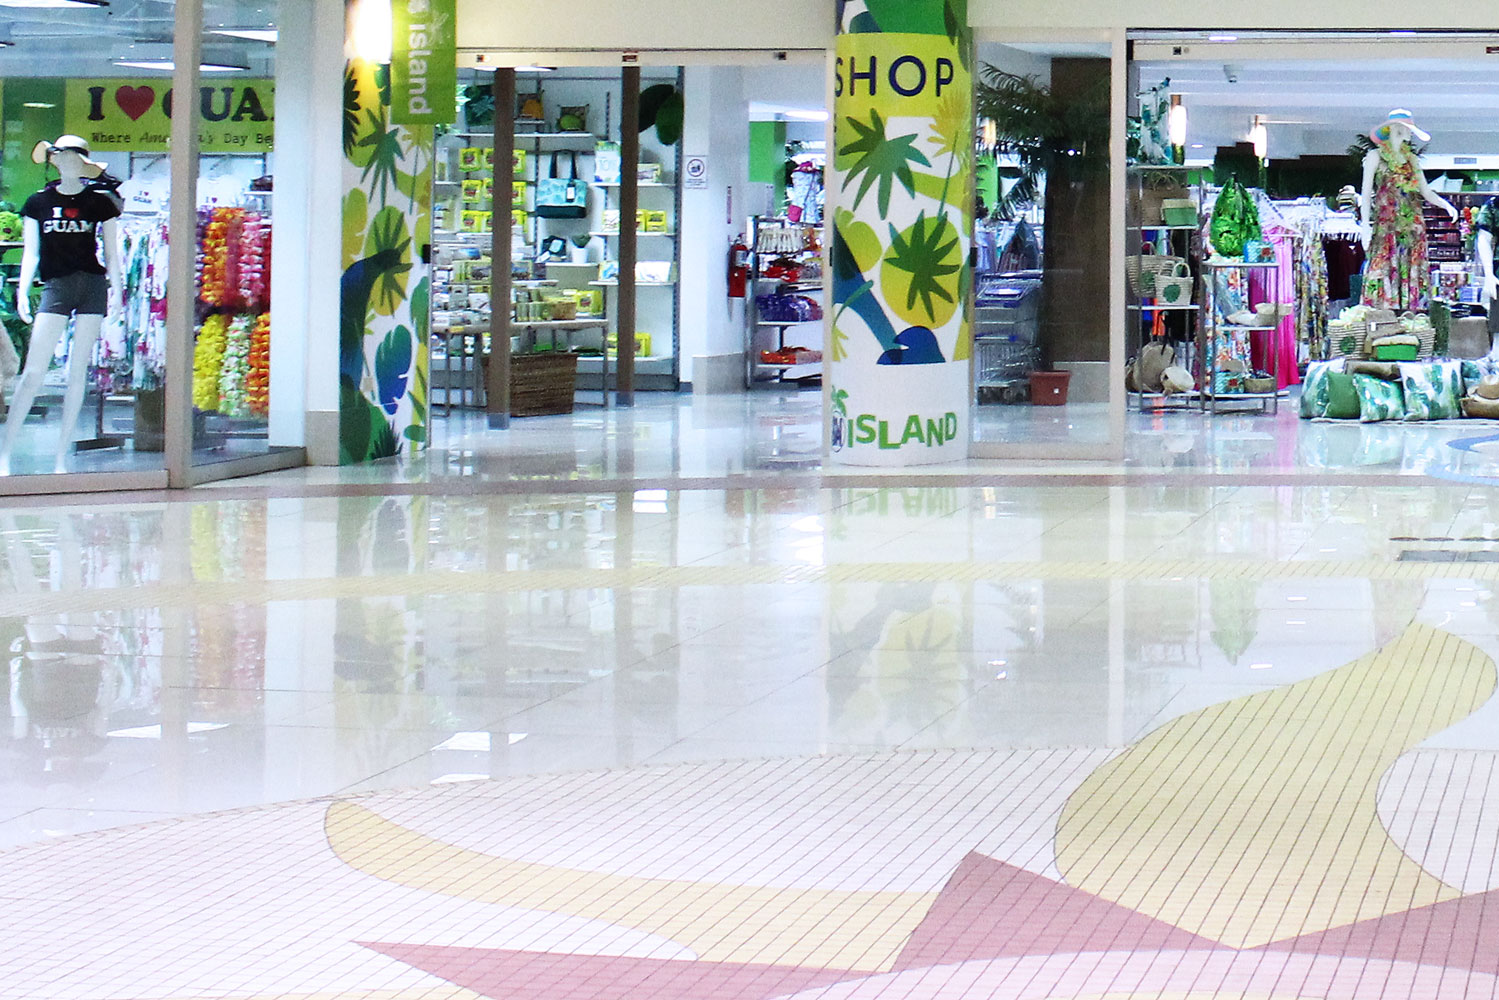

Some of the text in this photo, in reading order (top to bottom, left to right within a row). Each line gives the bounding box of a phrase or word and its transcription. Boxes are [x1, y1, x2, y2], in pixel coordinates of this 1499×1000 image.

[408, 24, 433, 115] island
[87, 85, 275, 123] I UA
[91, 131, 132, 144] Where
[223, 132, 248, 147] Day
[52, 207, 63, 219] I
[42, 220, 94, 234] GUAM
[847, 411, 958, 450] ISLAND
